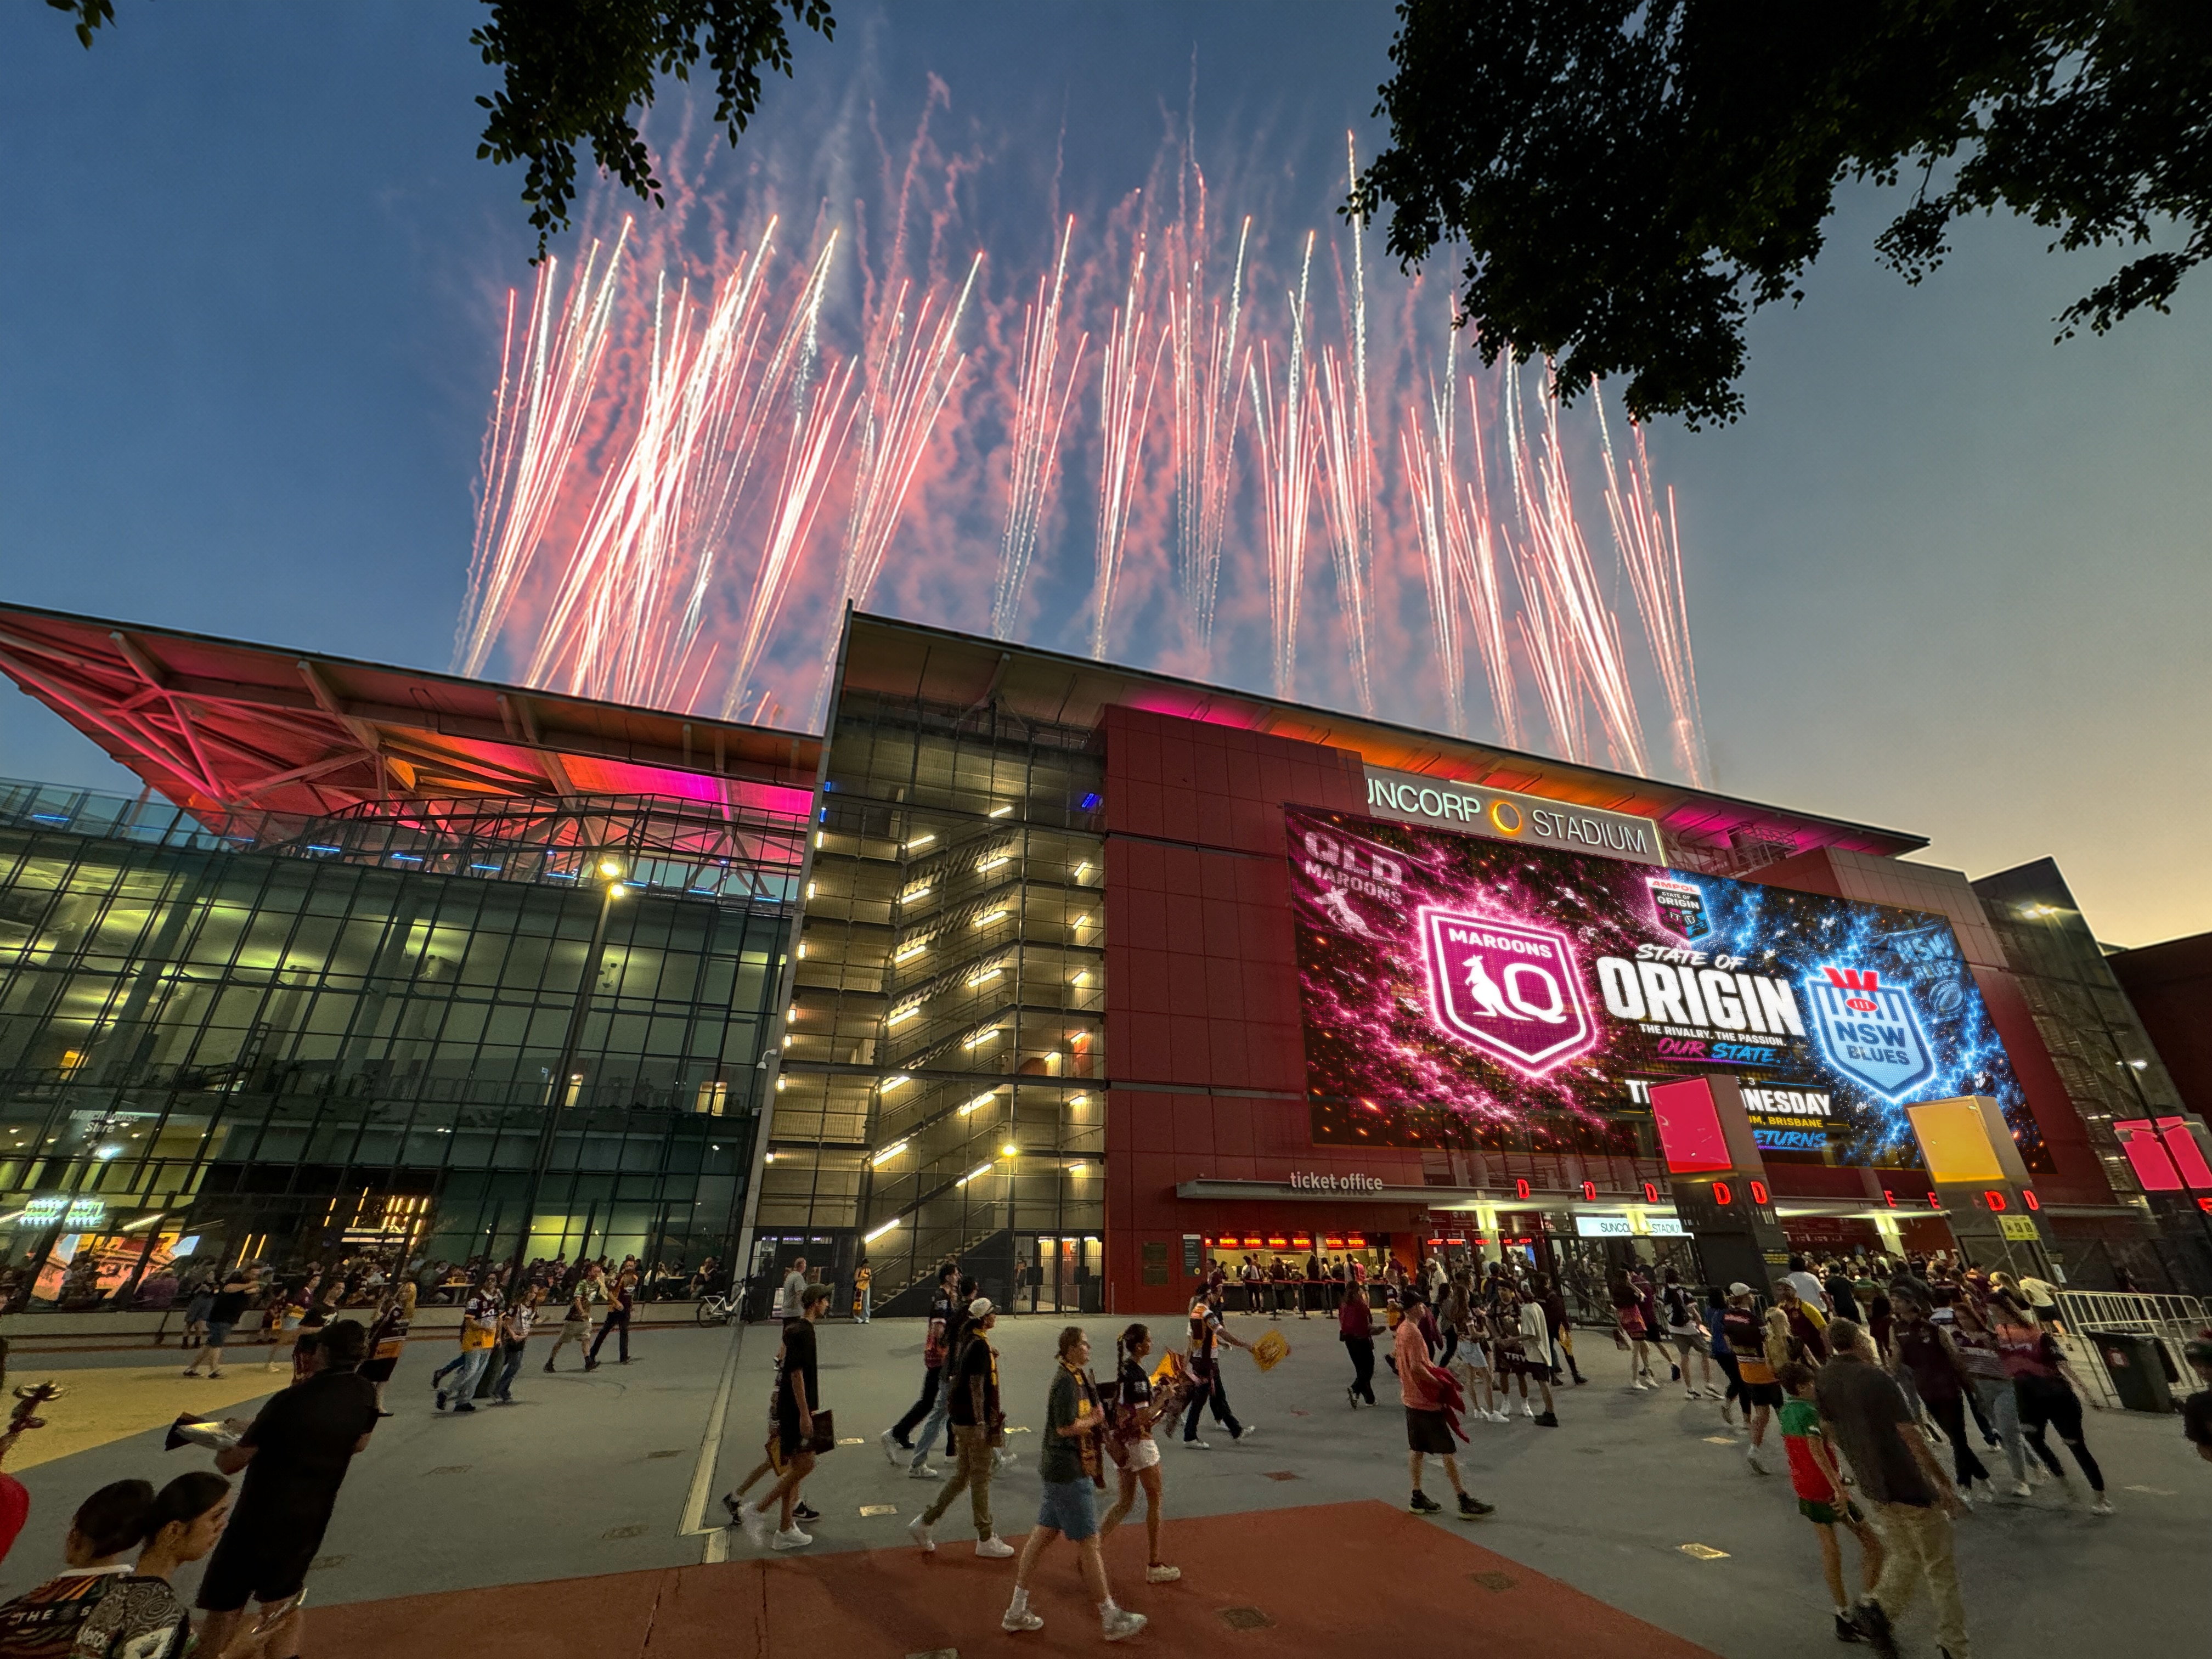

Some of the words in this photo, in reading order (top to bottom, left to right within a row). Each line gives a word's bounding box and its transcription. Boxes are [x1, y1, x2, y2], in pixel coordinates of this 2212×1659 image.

[1533, 810, 1647, 854] STADIUM
[1305, 831, 1402, 885] QLD
[1305, 860, 1402, 905] MAROONS
[1652, 881, 1696, 893] AMPOL
[1657, 896, 1700, 910] ORIGIN
[1448, 928, 1553, 958] MAROONS
[1893, 933, 1954, 964] NSW
[1635, 944, 1709, 966] STATE
[1715, 954, 1747, 971] OF
[1912, 960, 1960, 980] BLUES
[1596, 956, 1806, 1036] ORIGIN
[1639, 1024, 1663, 1035] THE
[1664, 1027, 1713, 1040] RIVALRY.
[1714, 1031, 1736, 1042] THE
[1737, 1034, 1787, 1046] PASSION.
[1833, 1020, 1906, 1048] NSW
[1657, 1037, 1706, 1057] OUR
[1711, 1042, 1783, 1063] STATE.
[1846, 1045, 1910, 1065] BLUES
[1768, 1116, 1824, 1128] BRISBANE
[1754, 1130, 1827, 1148] ETURNS
[1290, 1171, 1336, 1189] ticket
[1340, 1172, 1383, 1190] office
[1517, 1179, 1530, 1199] D
[1584, 1181, 1596, 1200] D
[1645, 1183, 1657, 1202] D
[1712, 1182, 1731, 1205] D
[1750, 1181, 1768, 1204] D
[1883, 1190, 1897, 1207] E
[1984, 1190, 2006, 1211] D
